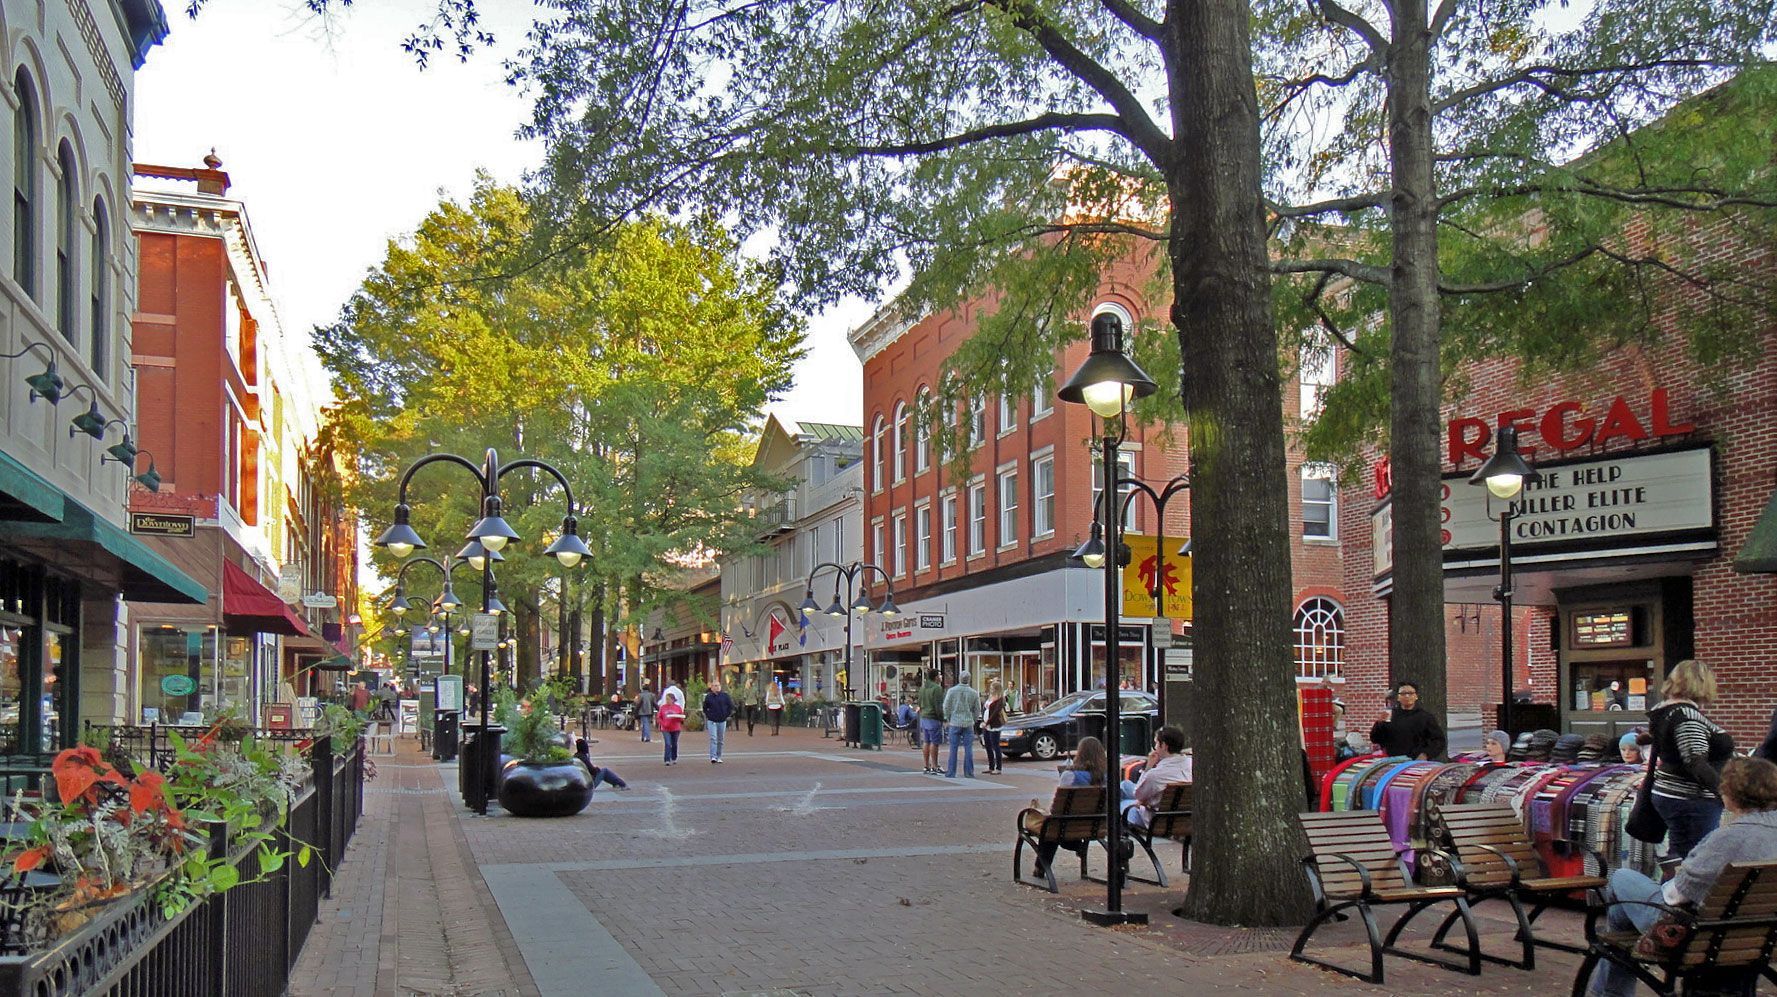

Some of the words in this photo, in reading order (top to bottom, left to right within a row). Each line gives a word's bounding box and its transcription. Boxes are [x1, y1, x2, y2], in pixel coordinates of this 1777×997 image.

[1448, 389, 1696, 464] REGAL
[1573, 465, 1622, 486] HELP
[1509, 495, 1575, 515] KILLER
[1588, 487, 1647, 508] ELITE
[1517, 512, 1635, 538] CONTAGION
